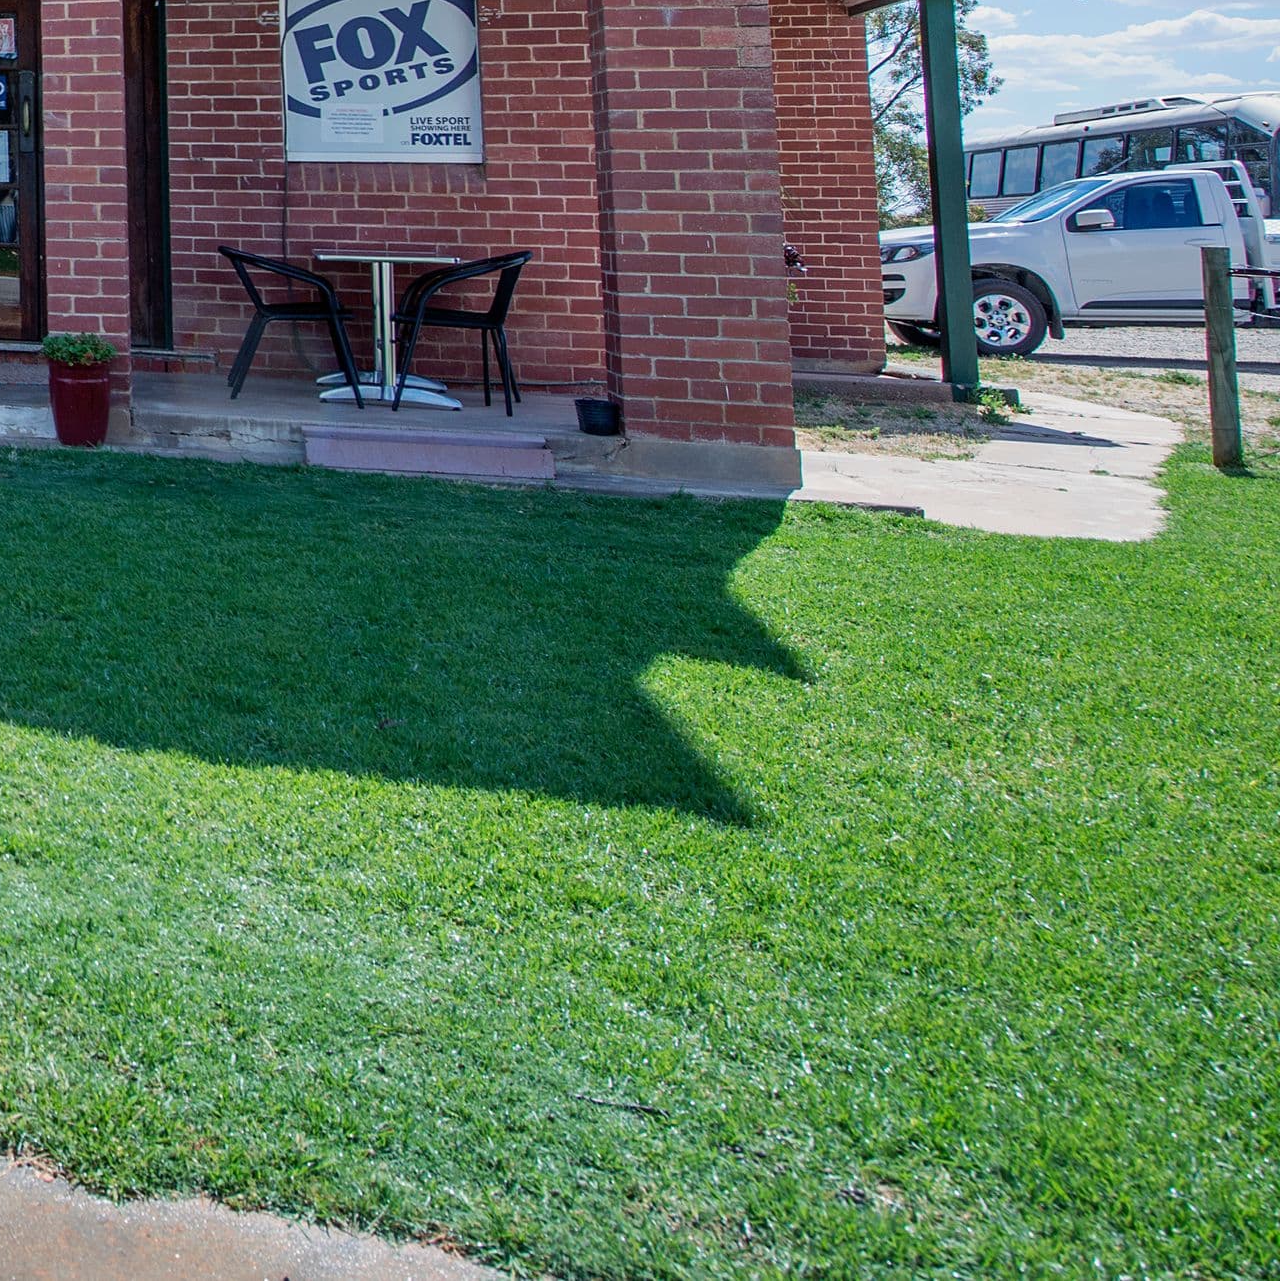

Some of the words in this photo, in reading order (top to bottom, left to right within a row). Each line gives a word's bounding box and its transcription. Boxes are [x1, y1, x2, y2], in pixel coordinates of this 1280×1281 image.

[293, 0, 450, 85] FOX
[309, 57, 455, 102] SPORTS
[410, 117, 433, 125] LIVE
[435, 117, 471, 125] SPORT
[411, 133, 472, 146] FOXTEL
